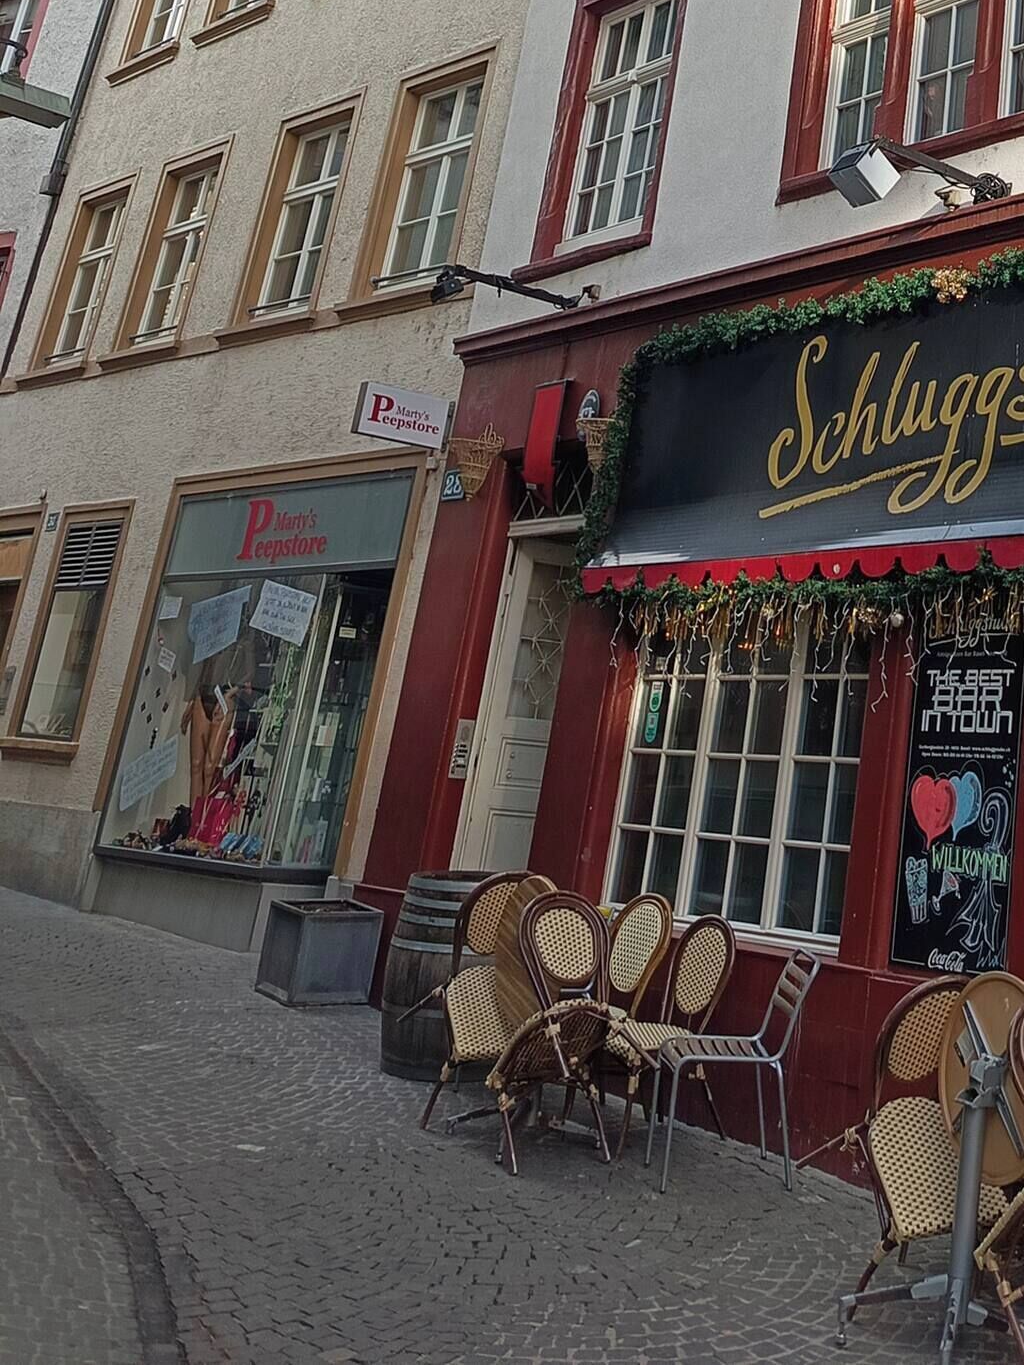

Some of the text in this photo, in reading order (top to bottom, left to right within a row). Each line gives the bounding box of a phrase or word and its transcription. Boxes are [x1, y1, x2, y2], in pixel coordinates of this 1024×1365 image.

[367, 393, 440, 435] Peepstore
[396, 405, 430, 421] Marty's
[236, 499, 327, 564] Peepstore
[273, 508, 317, 533] Marty's
[926, 669, 1015, 687] THE BEST
[931, 685, 1003, 713] BAR
[920, 709, 1013, 734] IN TOWN
[931, 843, 1008, 883] WILLKOMMEN
